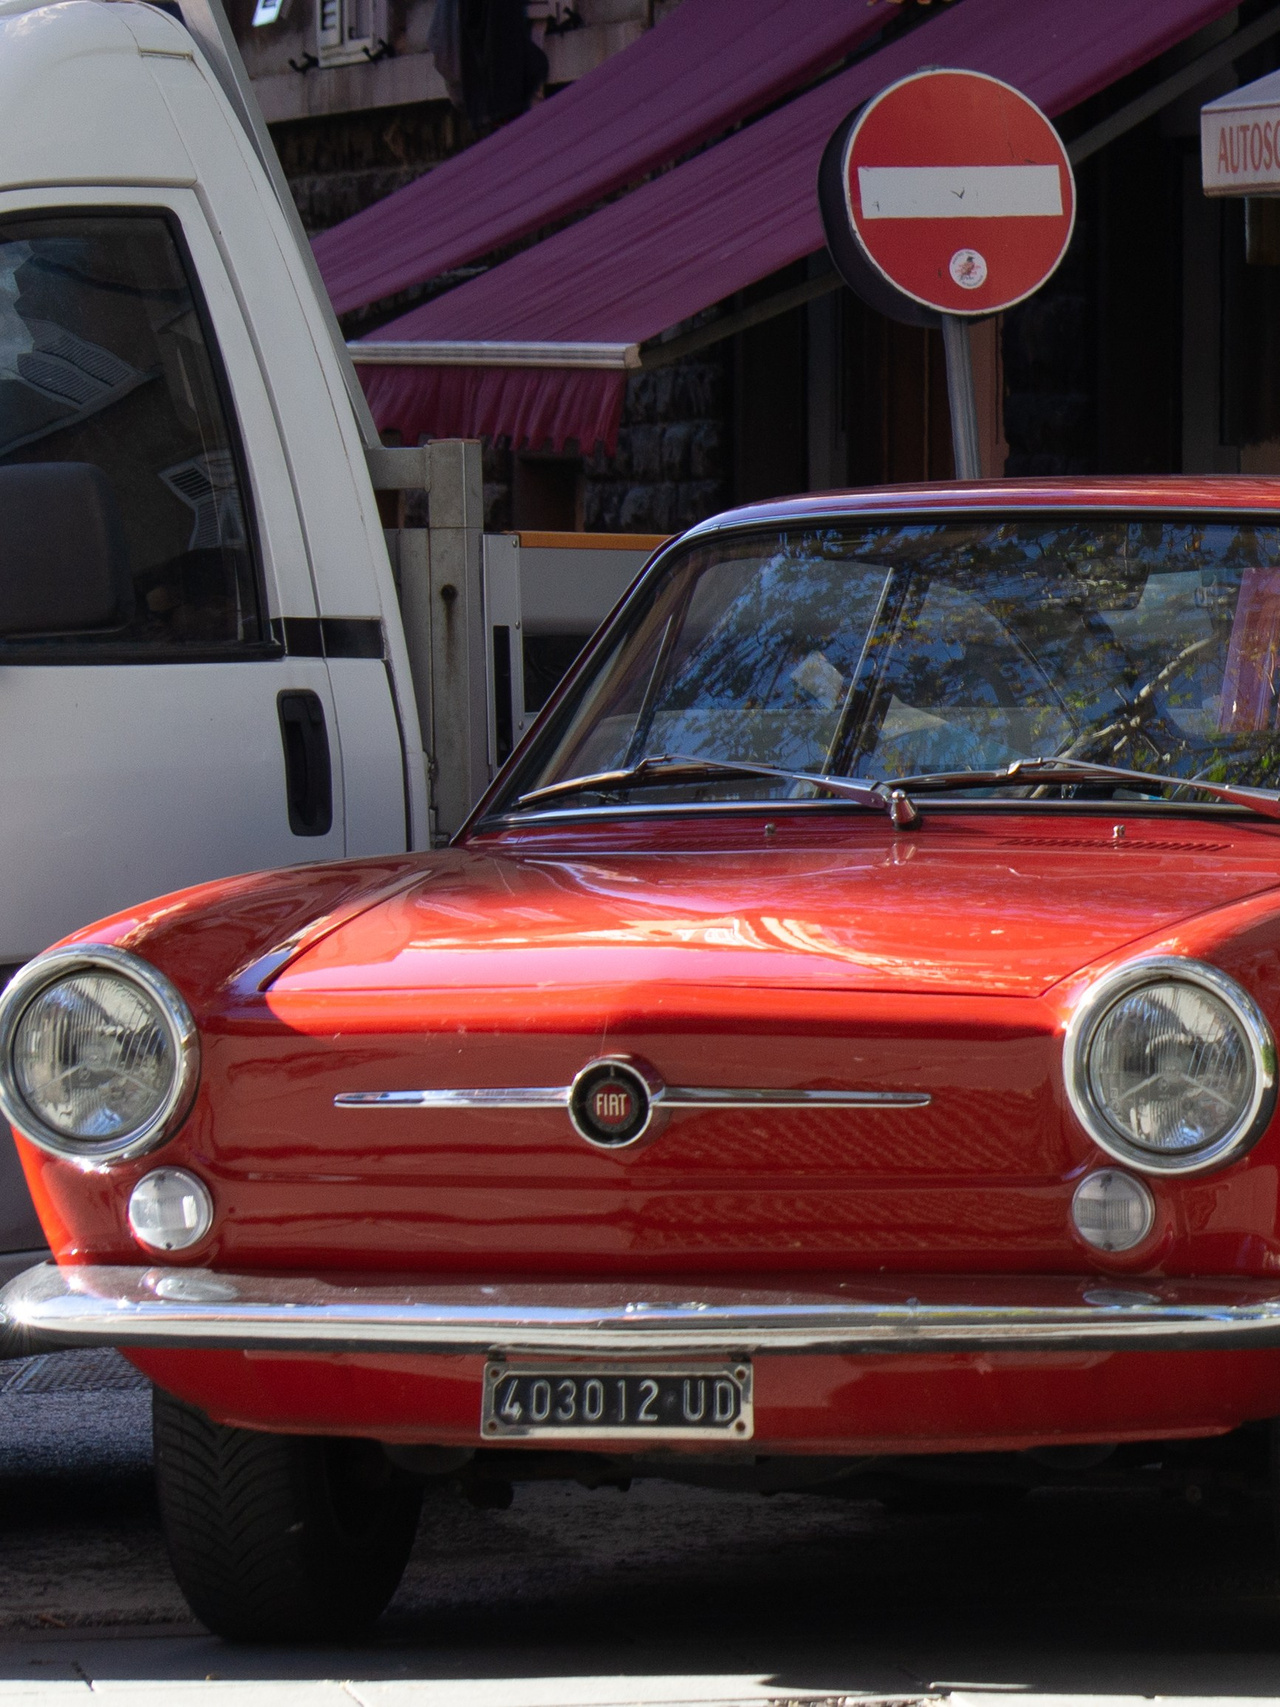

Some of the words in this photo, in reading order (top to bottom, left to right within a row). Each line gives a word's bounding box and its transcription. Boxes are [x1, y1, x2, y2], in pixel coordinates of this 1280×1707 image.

[595, 1093, 628, 1117] FIAT
[501, 1378, 659, 1422] 403012
[683, 1379, 736, 1422] UD
